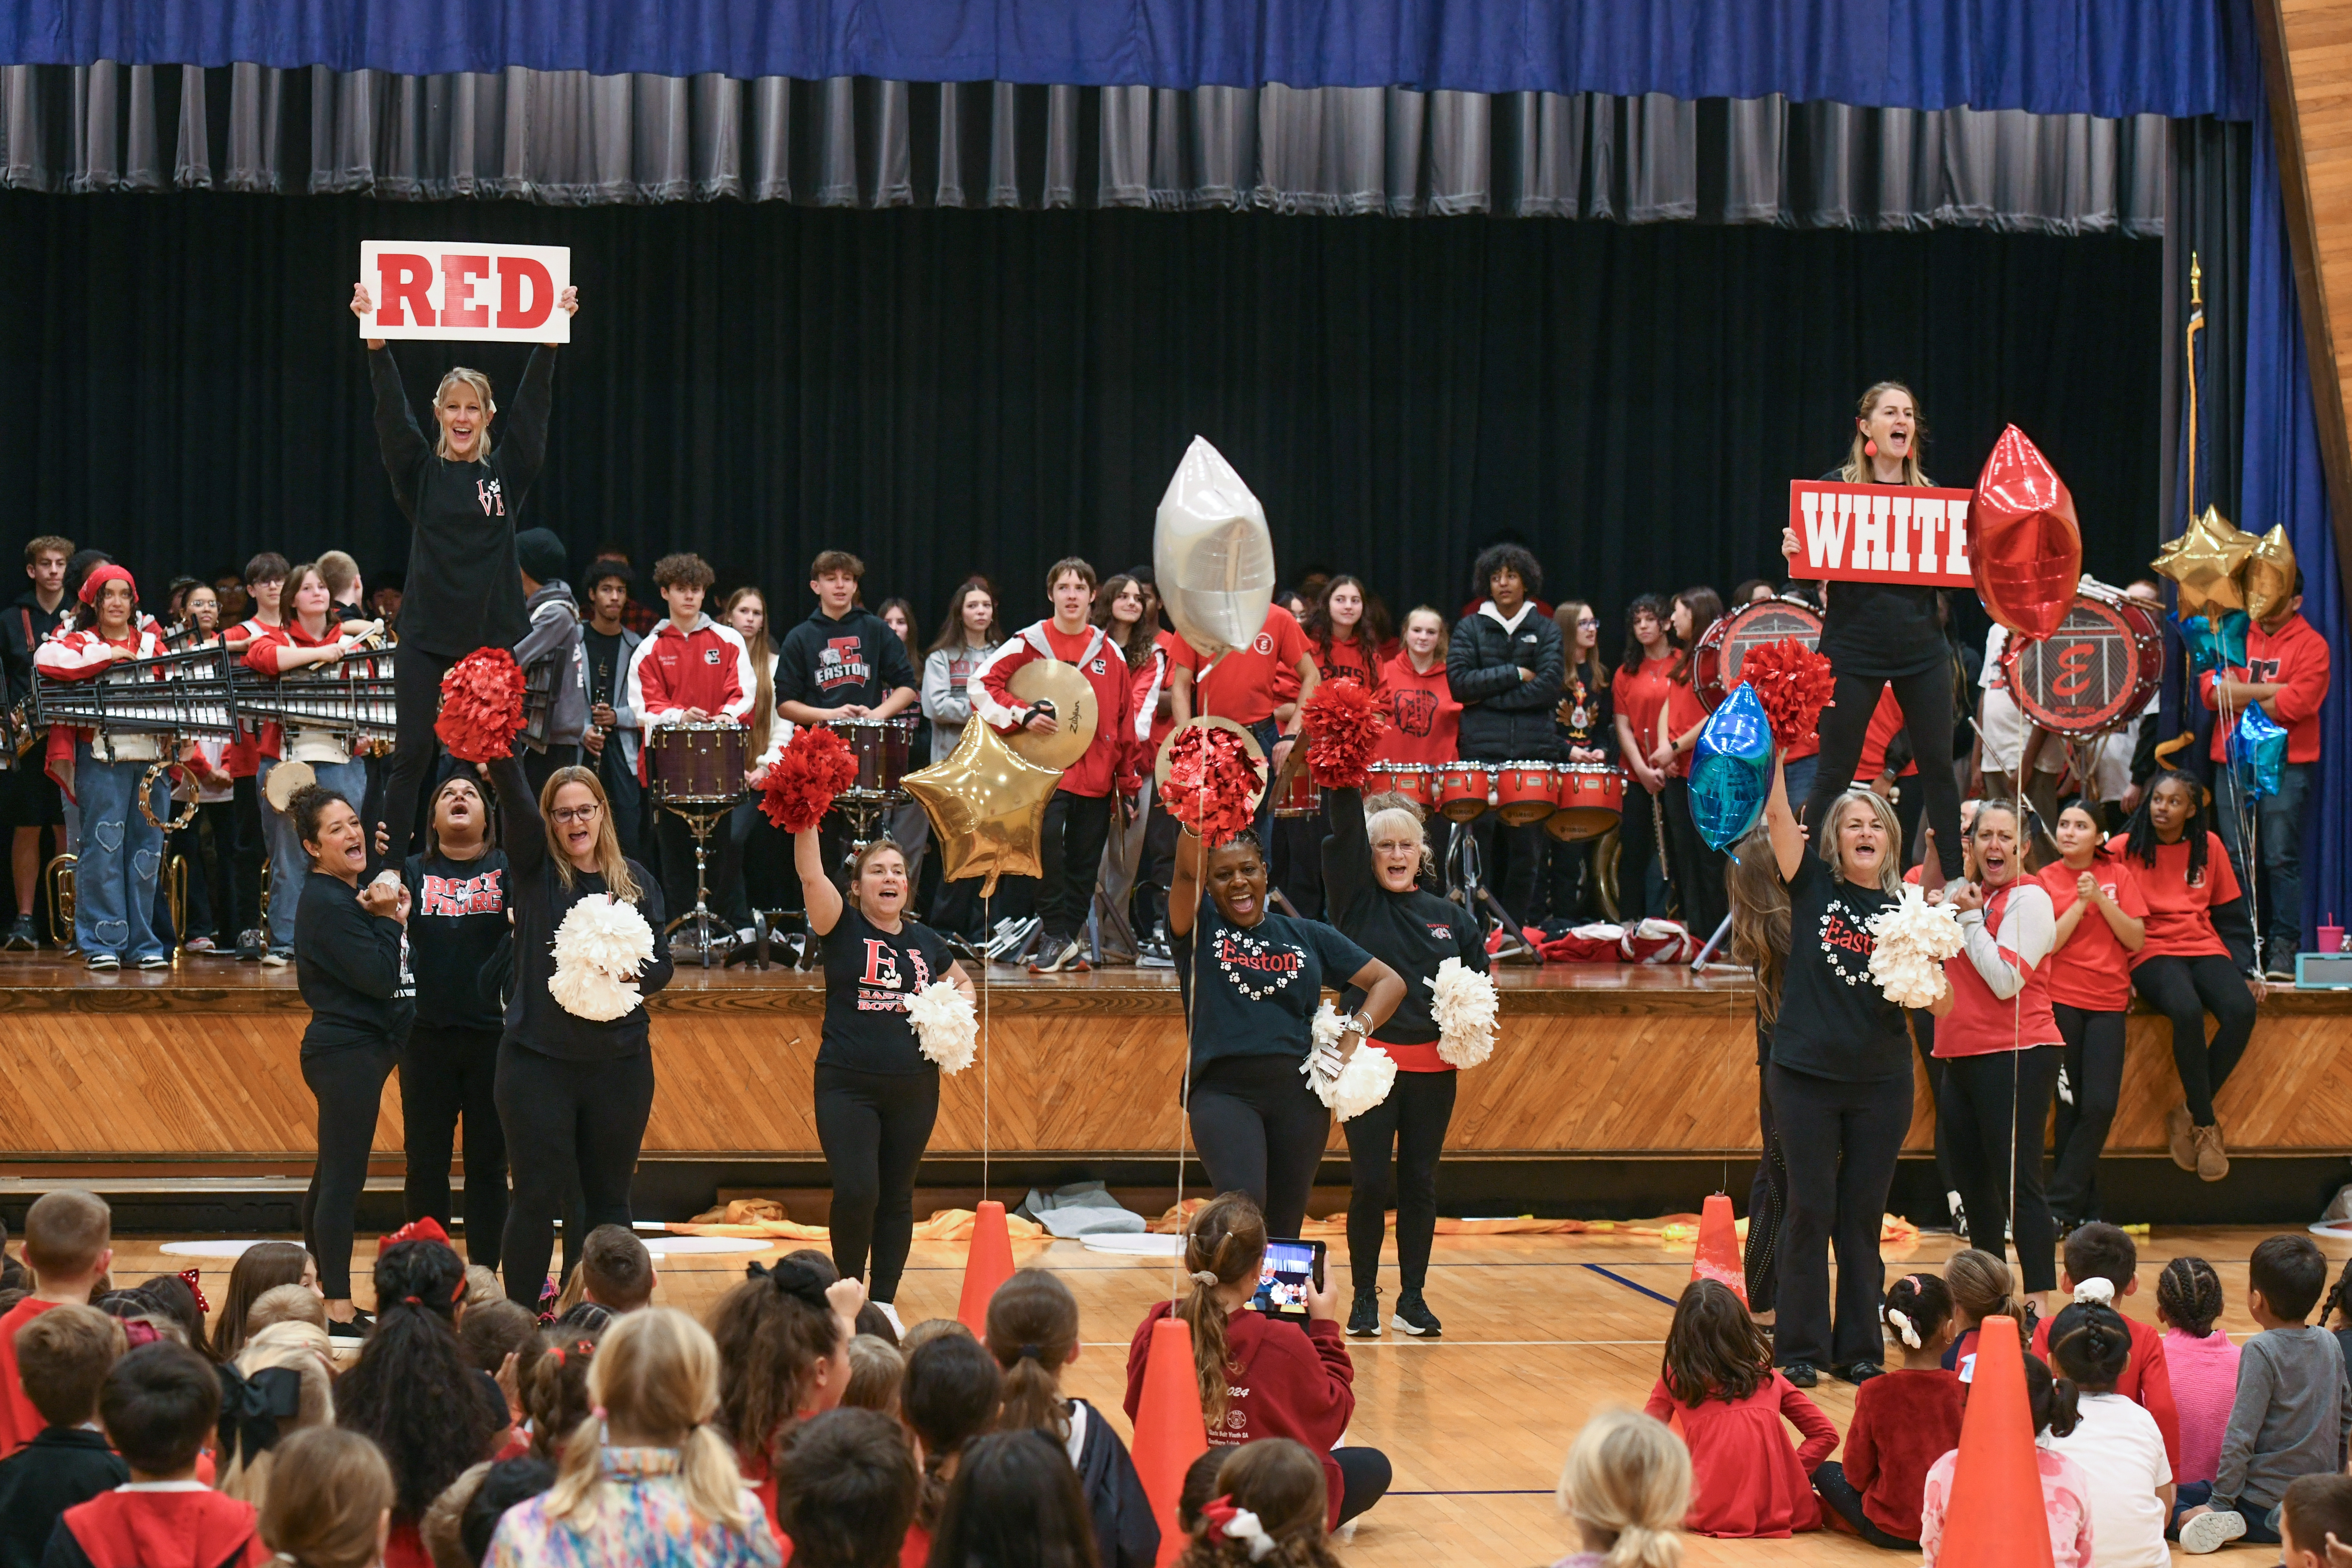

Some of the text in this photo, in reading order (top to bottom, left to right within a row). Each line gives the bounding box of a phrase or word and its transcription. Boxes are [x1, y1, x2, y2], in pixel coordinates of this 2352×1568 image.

[377, 254, 554, 329] RED
[1801, 492, 1971, 575] WHITE
[828, 636, 860, 664] E
[816, 663, 869, 683] EASTON
[2053, 643, 2094, 697] E
[1069, 700, 1082, 735] Zildjian
[423, 869, 502, 897] BEAT
[420, 889, 503, 917] PBURG
[1823, 915, 1877, 956] East
[859, 938, 902, 989] E
[1221, 938, 1298, 972] Easton
[857, 990, 905, 1001] EAST
[1227, 1386, 1250, 1398] 024
